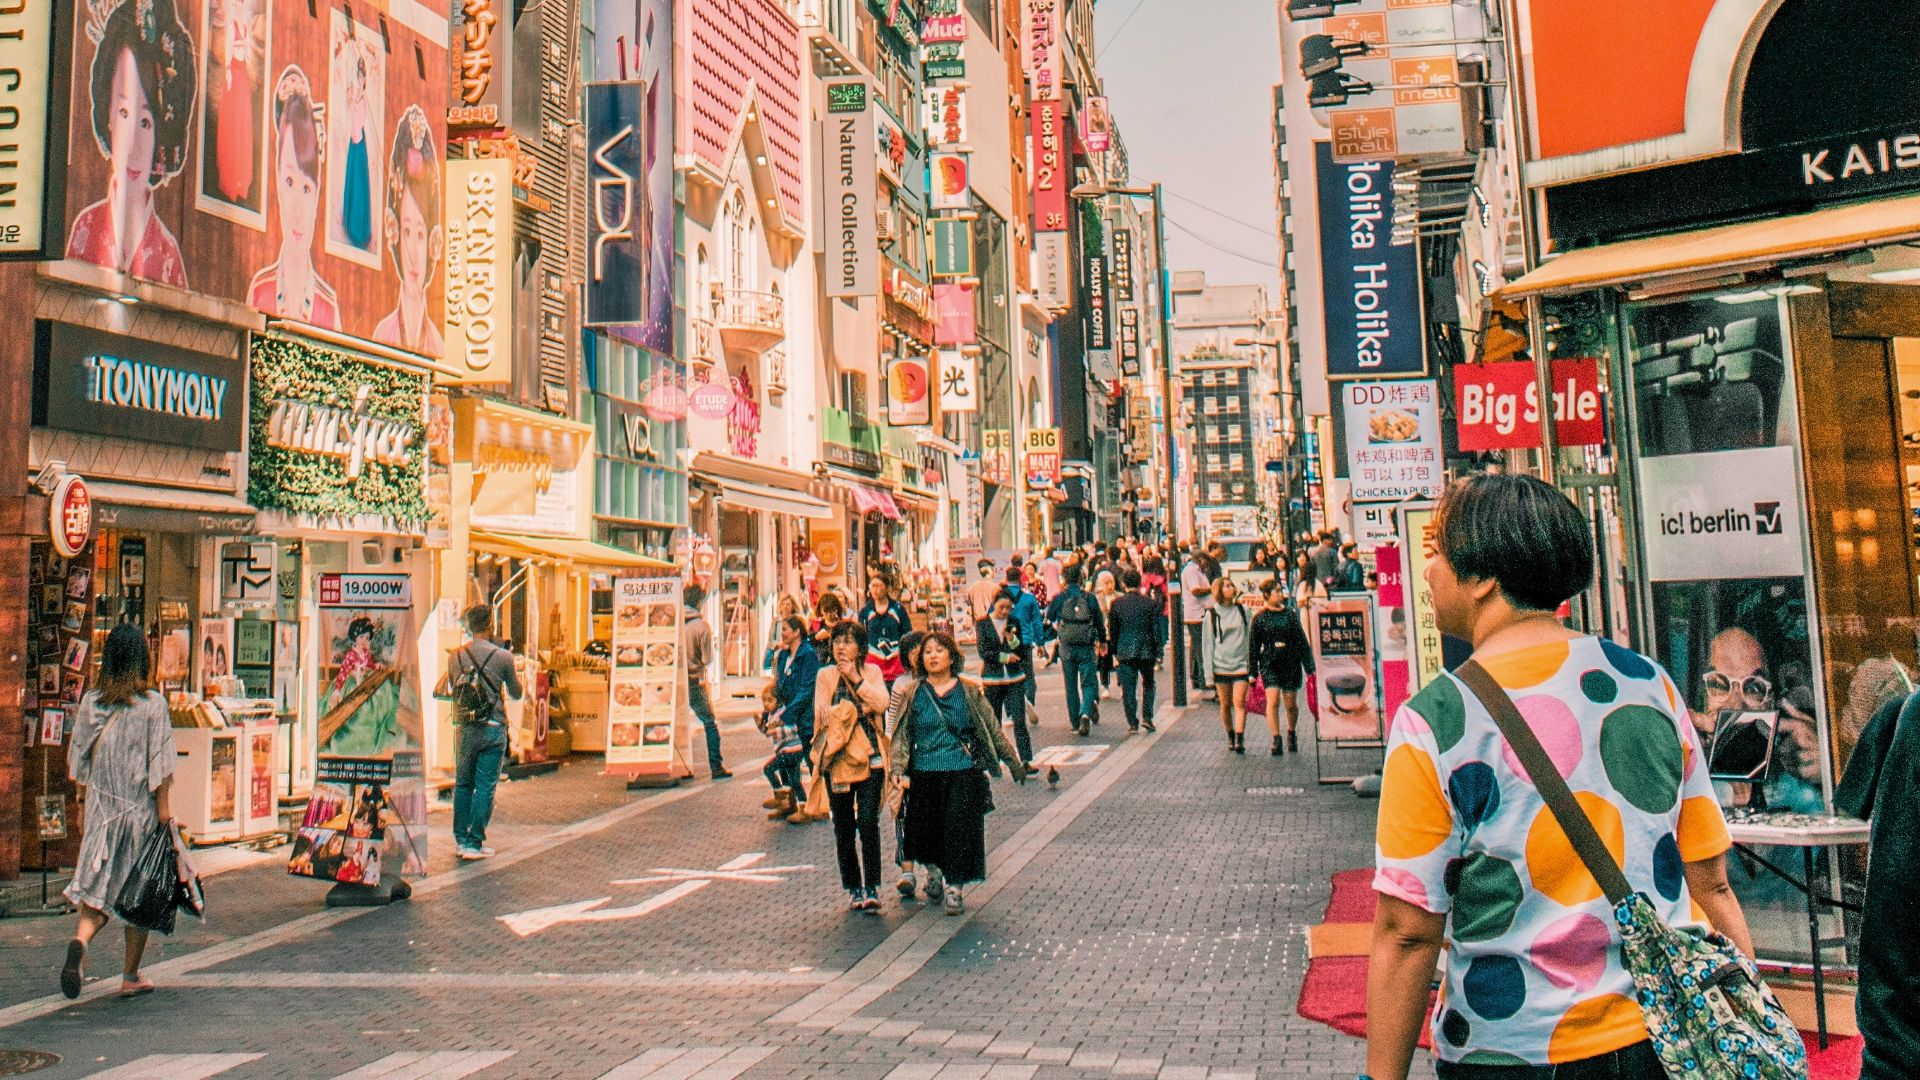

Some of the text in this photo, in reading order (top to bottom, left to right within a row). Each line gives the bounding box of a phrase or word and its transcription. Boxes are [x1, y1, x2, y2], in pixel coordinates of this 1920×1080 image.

[1338, 124, 1390, 141] style
[1340, 138, 1392, 154] mall
[1039, 167, 1053, 191] 2
[840, 117, 859, 289] Nature Collection
[1046, 212, 1062, 227] 3F
[465, 172, 496, 372] SKINFOOD
[1090, 257, 1104, 347] HOLLYS COFFEE
[1353, 262, 1390, 368] Holika
[96, 354, 228, 421] TONYMOLY
[943, 366, 970, 397] 光
[696, 394, 728, 404] ETUDE
[1352, 386, 1386, 405] DD
[1462, 378, 1598, 435] Big Sale
[1031, 432, 1056, 447] BIG
[1029, 454, 1058, 470] MART
[1355, 487, 1401, 498] CHICKEN
[1409, 486, 1430, 496] PUB
[1660, 508, 1751, 536] ic! berlin
[1366, 531, 1388, 539] Bijou
